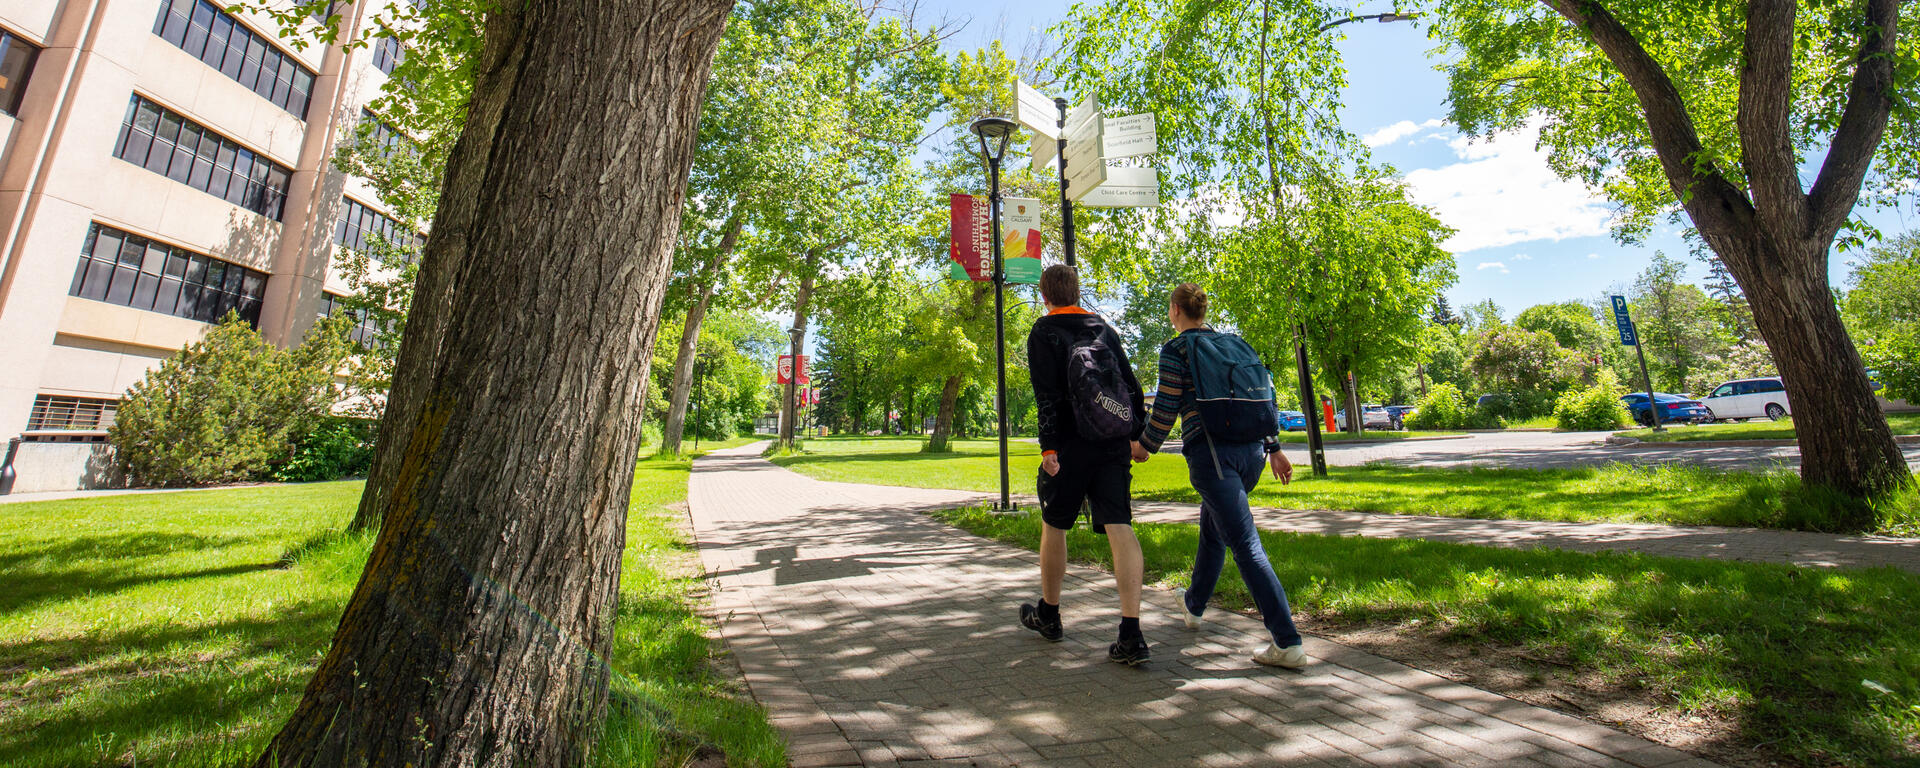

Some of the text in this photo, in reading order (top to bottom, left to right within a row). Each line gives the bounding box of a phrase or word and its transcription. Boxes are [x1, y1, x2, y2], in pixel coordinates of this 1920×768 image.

[1117, 118, 1140, 126] Faculties
[972, 198, 980, 252] SOMETHING
[979, 197, 990, 277] CHALLENGE
[1616, 298, 1624, 310] P
[1094, 391, 1131, 422] NITRO
